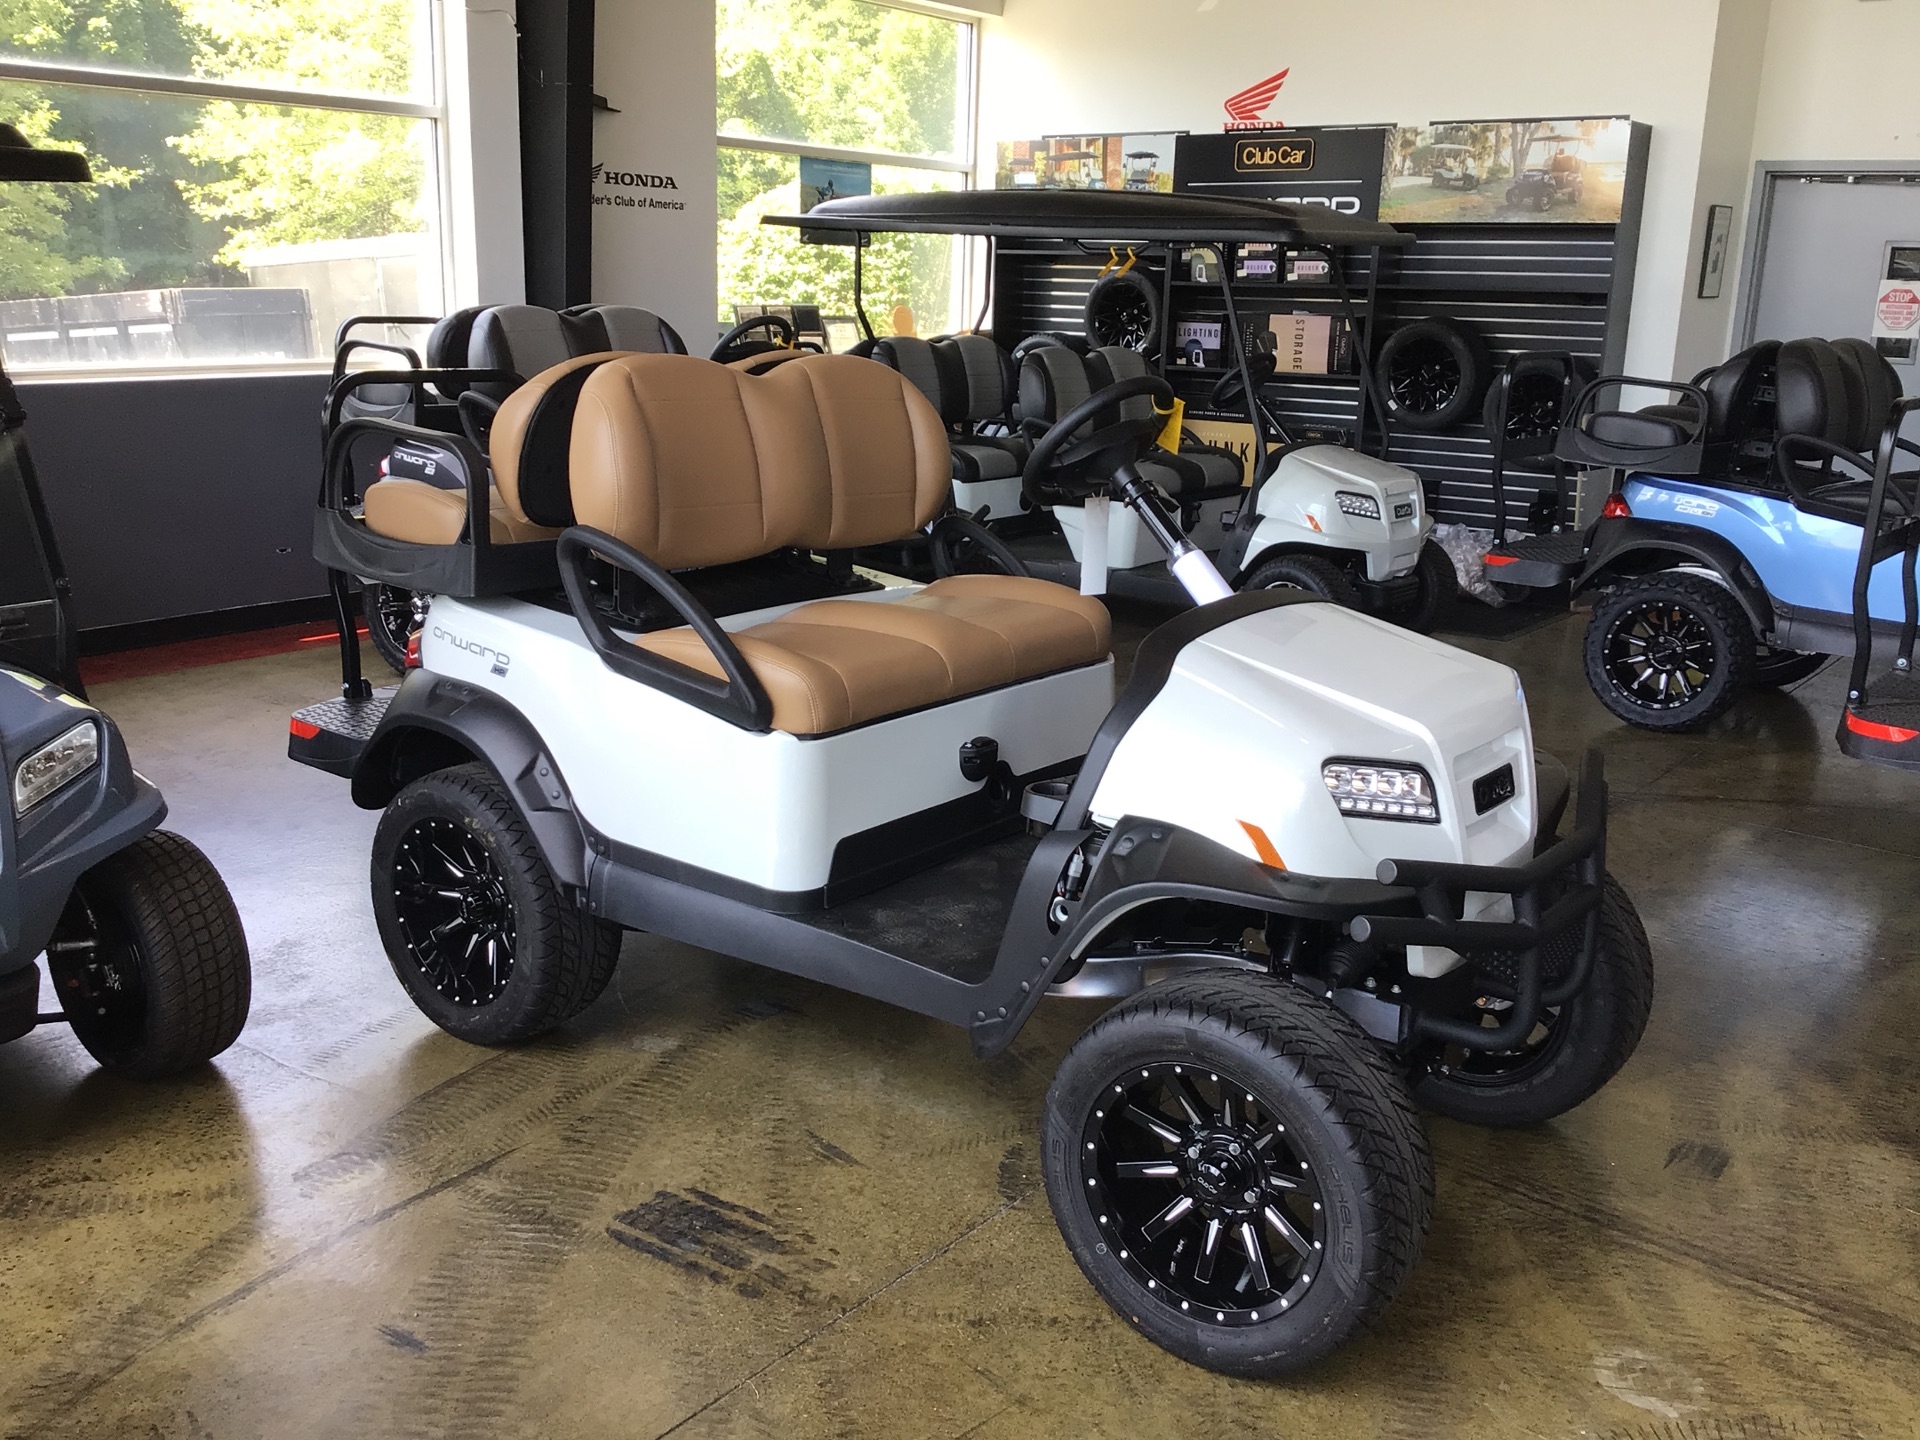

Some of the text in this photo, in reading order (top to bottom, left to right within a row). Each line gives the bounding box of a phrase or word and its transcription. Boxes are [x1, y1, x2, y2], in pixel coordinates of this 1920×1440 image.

[1243, 146, 1306, 165] Club Car
[603, 171, 679, 190] HONDA
[614, 195, 636, 208] Club
[637, 197, 647, 208] of
[649, 198, 685, 211] America
[1888, 291, 1914, 303] STOP
[1178, 328, 1219, 338] LIGHTING
[1292, 319, 1305, 370] STORAGE
